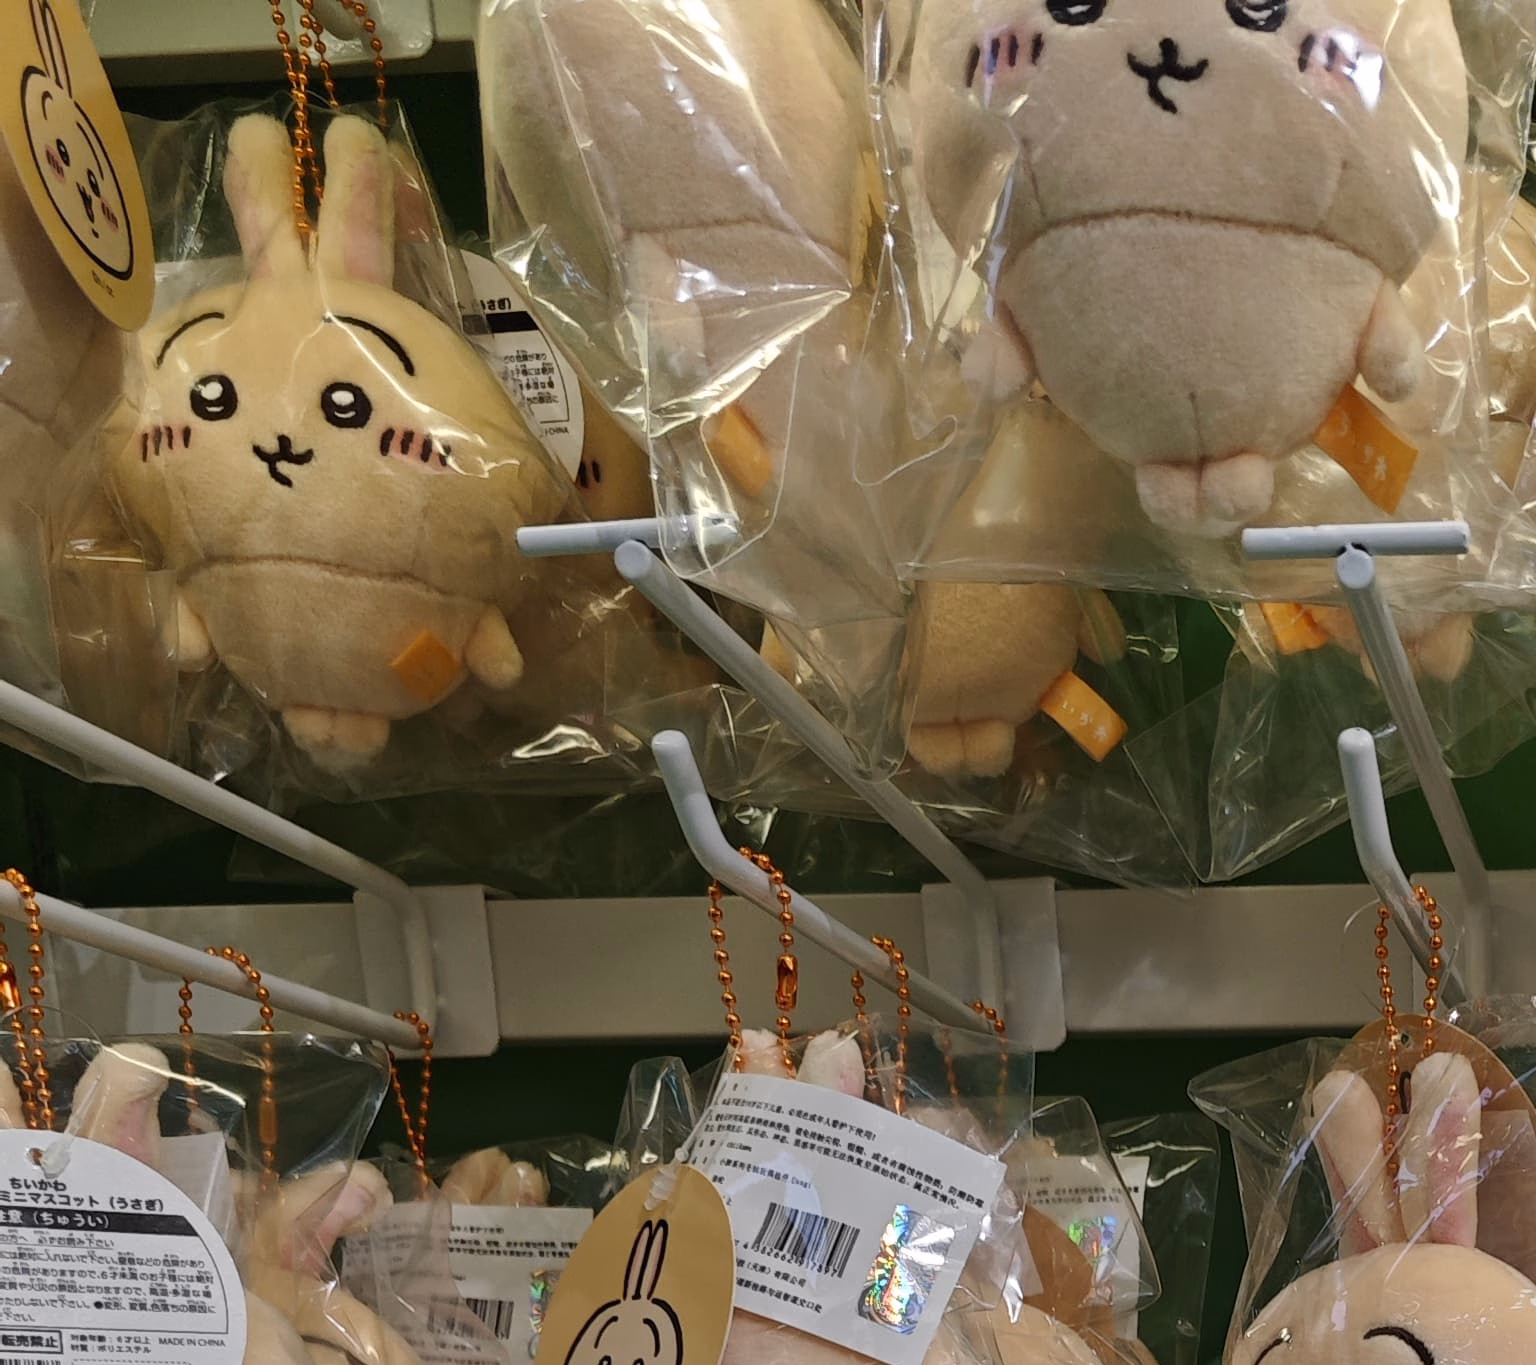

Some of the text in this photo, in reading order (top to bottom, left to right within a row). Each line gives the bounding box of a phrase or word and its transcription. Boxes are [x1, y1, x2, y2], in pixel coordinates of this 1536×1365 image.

[9, 1177, 68, 1192] ちいかわ
[2, 1334, 59, 1349] 転売禁止
[159, 1336, 185, 1346] MADE
[197, 1338, 226, 1348] CHINA
